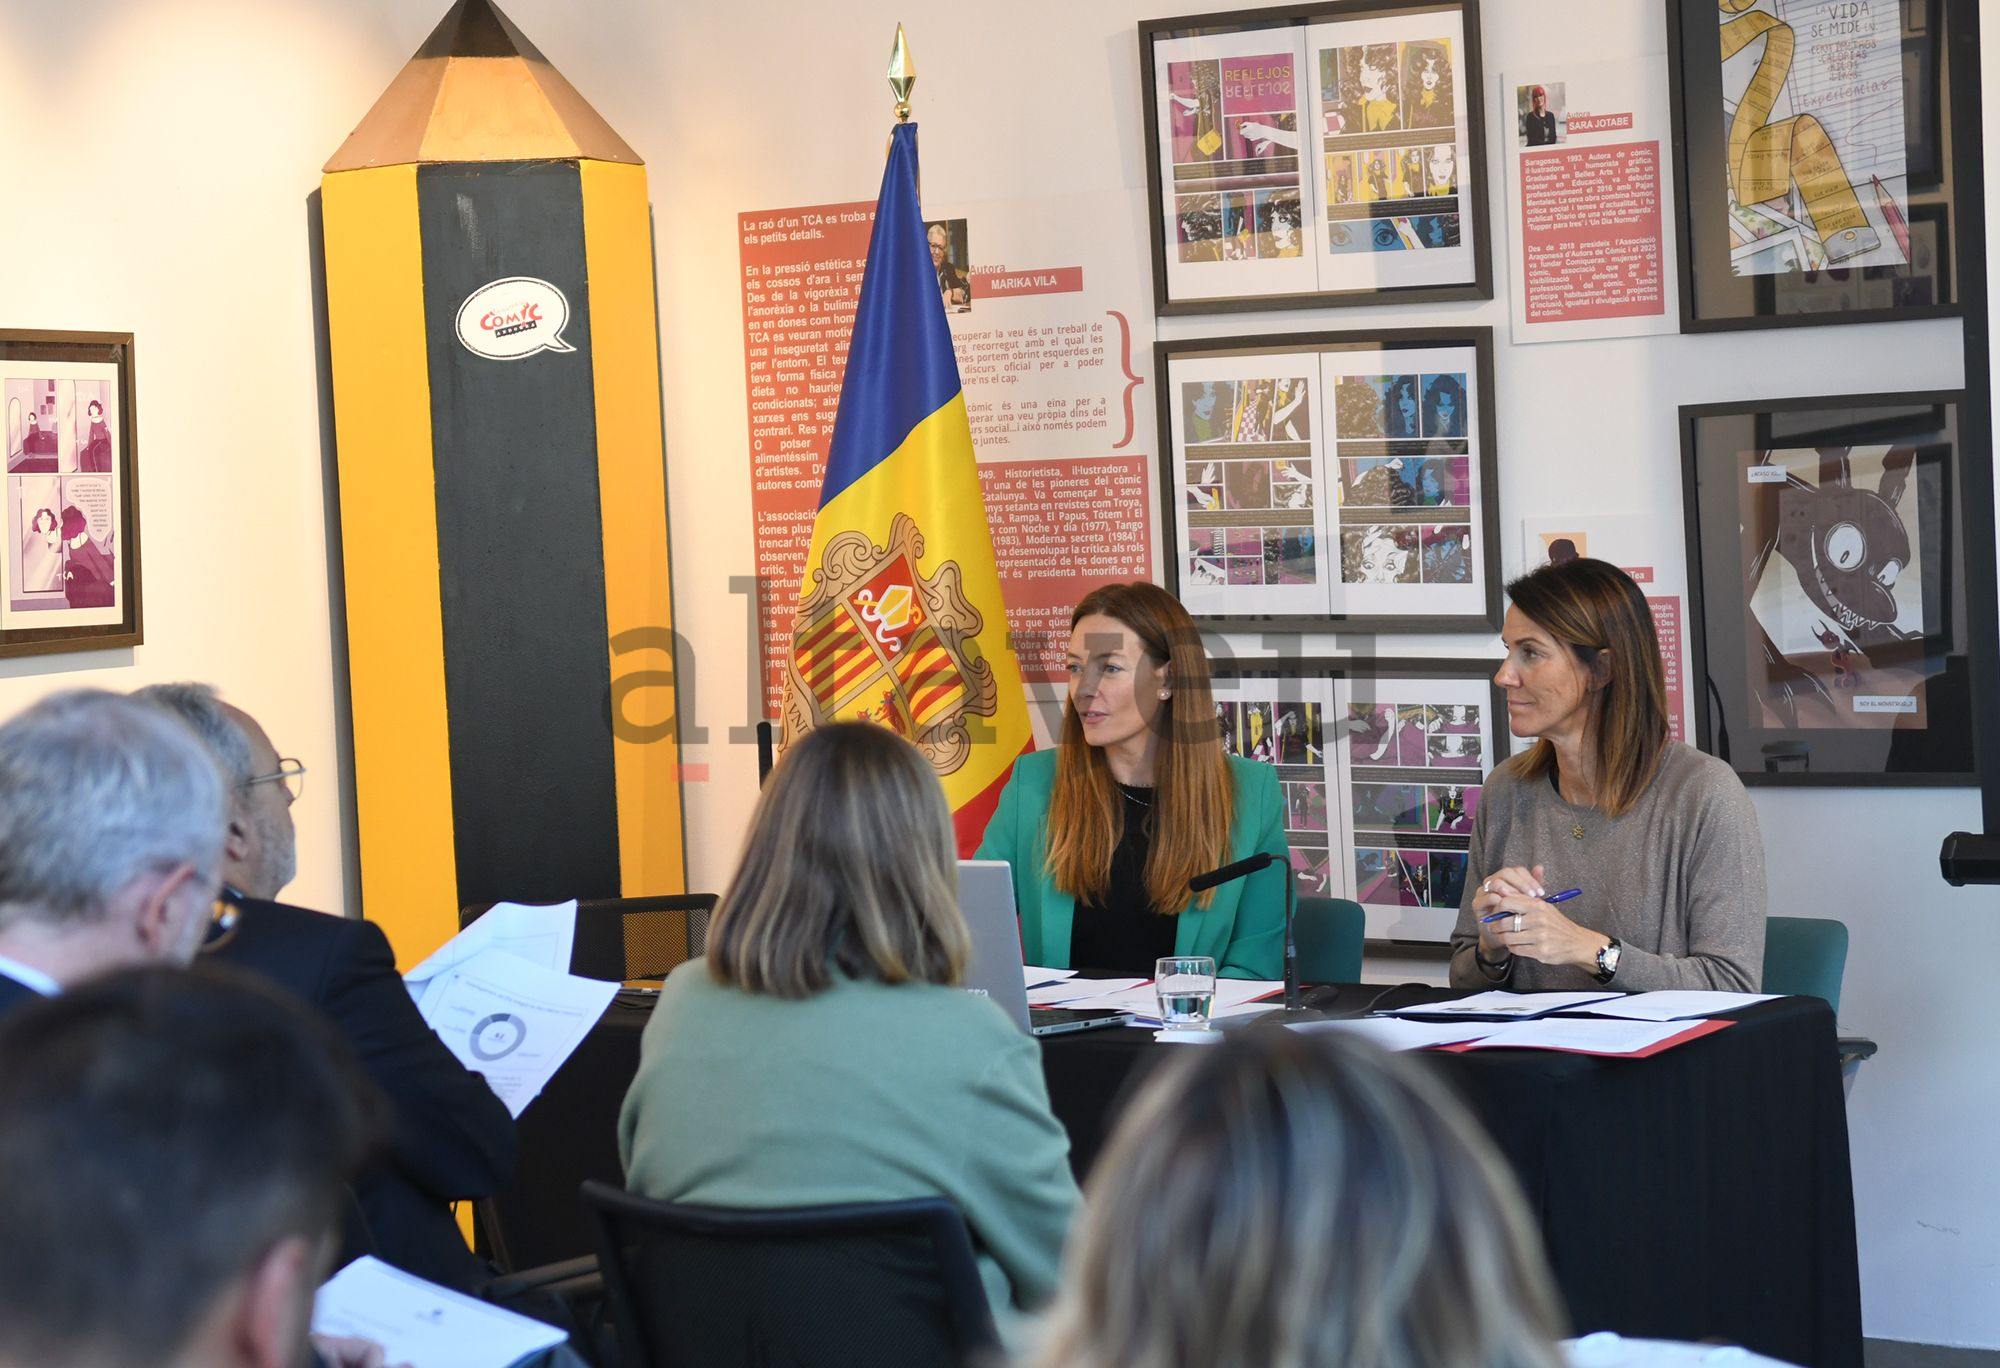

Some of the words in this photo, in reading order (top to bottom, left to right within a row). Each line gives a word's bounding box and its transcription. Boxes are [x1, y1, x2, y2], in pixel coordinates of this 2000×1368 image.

[1828, 1, 1870, 19] VIDA
[1810, 24, 1823, 37] SE
[1829, 20, 1860, 35] MIDE
[1225, 65, 1290, 82] REFLEJOS
[1569, 120, 1592, 130] SARA
[1594, 116, 1628, 128] JOTABE
[743, 220, 754, 231] La
[759, 218, 773, 229] raó
[778, 216, 798, 228] d'un
[802, 214, 822, 226] TCA
[825, 215, 836, 224] es
[840, 211, 865, 223] troba
[744, 233, 757, 244] els
[761, 231, 786, 246] petits
[790, 228, 824, 241] detalls.
[746, 265, 758, 276] En
[762, 264, 770, 275] la
[775, 262, 810, 277] pressió
[814, 258, 851, 271] estètica
[970, 264, 1005, 275] Autora
[746, 278, 759, 289] els
[766, 277, 800, 288] cossos
[806, 273, 830, 285] d'ara
[836, 273, 838, 283] i
[991, 277, 1030, 289] MARIKA
[1033, 275, 1056, 286] VILA
[747, 292, 765, 303] Des
[771, 291, 782, 301] de
[789, 289, 797, 300] la
[804, 286, 848, 302] vigorèxia
[748, 303, 793, 316] l'anorèxia
[799, 305, 804, 313] o
[810, 302, 818, 312] la
[749, 321, 759, 329] en
[763, 320, 774, 329] en
[778, 316, 806, 328] dones
[810, 316, 830, 325] com
[996, 327, 1003, 337] la
[1007, 328, 1023, 336] veu
[1028, 325, 1037, 335] és
[1041, 327, 1052, 335] un
[1057, 322, 1086, 334] treball
[1091, 322, 1102, 332] de
[749, 332, 769, 343] TCA
[773, 333, 783, 341] es
[788, 330, 820, 340] veuran
[972, 339, 1018, 353] recorregut
[1025, 337, 1044, 347] amb
[1051, 336, 1058, 346] el
[1065, 334, 1084, 348] qual
[1090, 333, 1102, 344] les
[749, 347, 767, 356] una
[774, 342, 828, 358] inseguretat
[977, 350, 1008, 364] portem
[1012, 348, 1039, 359] obrint
[1043, 345, 1088, 360] esquerdes
[1092, 347, 1103, 355] en
[750, 361, 765, 372] per
[772, 356, 809, 368] l'entorn.
[817, 355, 825, 365] El
[965, 362, 995, 373] discurs
[1004, 360, 1030, 371] oficial
[1040, 361, 1053, 371] per
[1063, 360, 1068, 368] a
[1077, 356, 1103, 369] poder
[751, 373, 770, 383] teva
[776, 370, 804, 382] forma
[810, 368, 836, 380] física
[991, 373, 998, 383] el
[1001, 375, 1018, 385] cap.
[752, 385, 775, 396] dieta
[786, 386, 798, 394] no
[752, 396, 816, 411] condicionats;
[1002, 399, 1011, 409] és
[1020, 400, 1037, 409] una
[1047, 397, 1065, 407] eina
[1076, 398, 1089, 408] per
[1100, 397, 1105, 405] a
[753, 414, 784, 423] xarxes
[791, 413, 808, 421] ens
[998, 413, 1013, 421] una
[1018, 412, 1033, 420] veu
[1037, 408, 1065, 421] pròpia
[1070, 407, 1088, 417] dins
[1092, 406, 1105, 416] del
[753, 425, 793, 436] contrari.
[798, 423, 816, 434] Res
[754, 440, 761, 450] O
[780, 438, 810, 451] potser
[755, 451, 817, 463] alimentéssim
[755, 464, 801, 476] d'artistes.
[1005, 467, 1062, 479] Historietista,
[1138, 463, 1140, 473] i
[756, 479, 792, 490] autores
[1016, 479, 1026, 489] de
[1032, 478, 1044, 488] les
[1050, 477, 1088, 490] pioneres
[1094, 476, 1108, 485] del
[1114, 474, 1140, 485] còmic
[1034, 490, 1045, 499] Va
[1053, 489, 1096, 501] començar
[1105, 487, 1112, 496] la
[1121, 487, 1141, 495] seva
[1005, 501, 1038, 511] setanta
[1041, 502, 1051, 510] en
[1055, 499, 1089, 509] revistes
[1092, 500, 1110, 508] com
[1113, 497, 1141, 509] Troya,
[1009, 512, 1041, 525] Rampa,
[1047, 511, 1054, 521] El
[1059, 510, 1088, 523] Papus,
[1093, 509, 1121, 519] Tótem
[1127, 509, 1129, 518] i
[1135, 508, 1142, 517] El
[759, 524, 787, 535] dones
[791, 523, 811, 536] plus
[1059, 556, 1070, 565] de
[1074, 555, 1086, 565] les
[1090, 554, 1117, 564] dones
[1136, 554, 1144, 563] el
[56, 571, 74, 581] TCA
